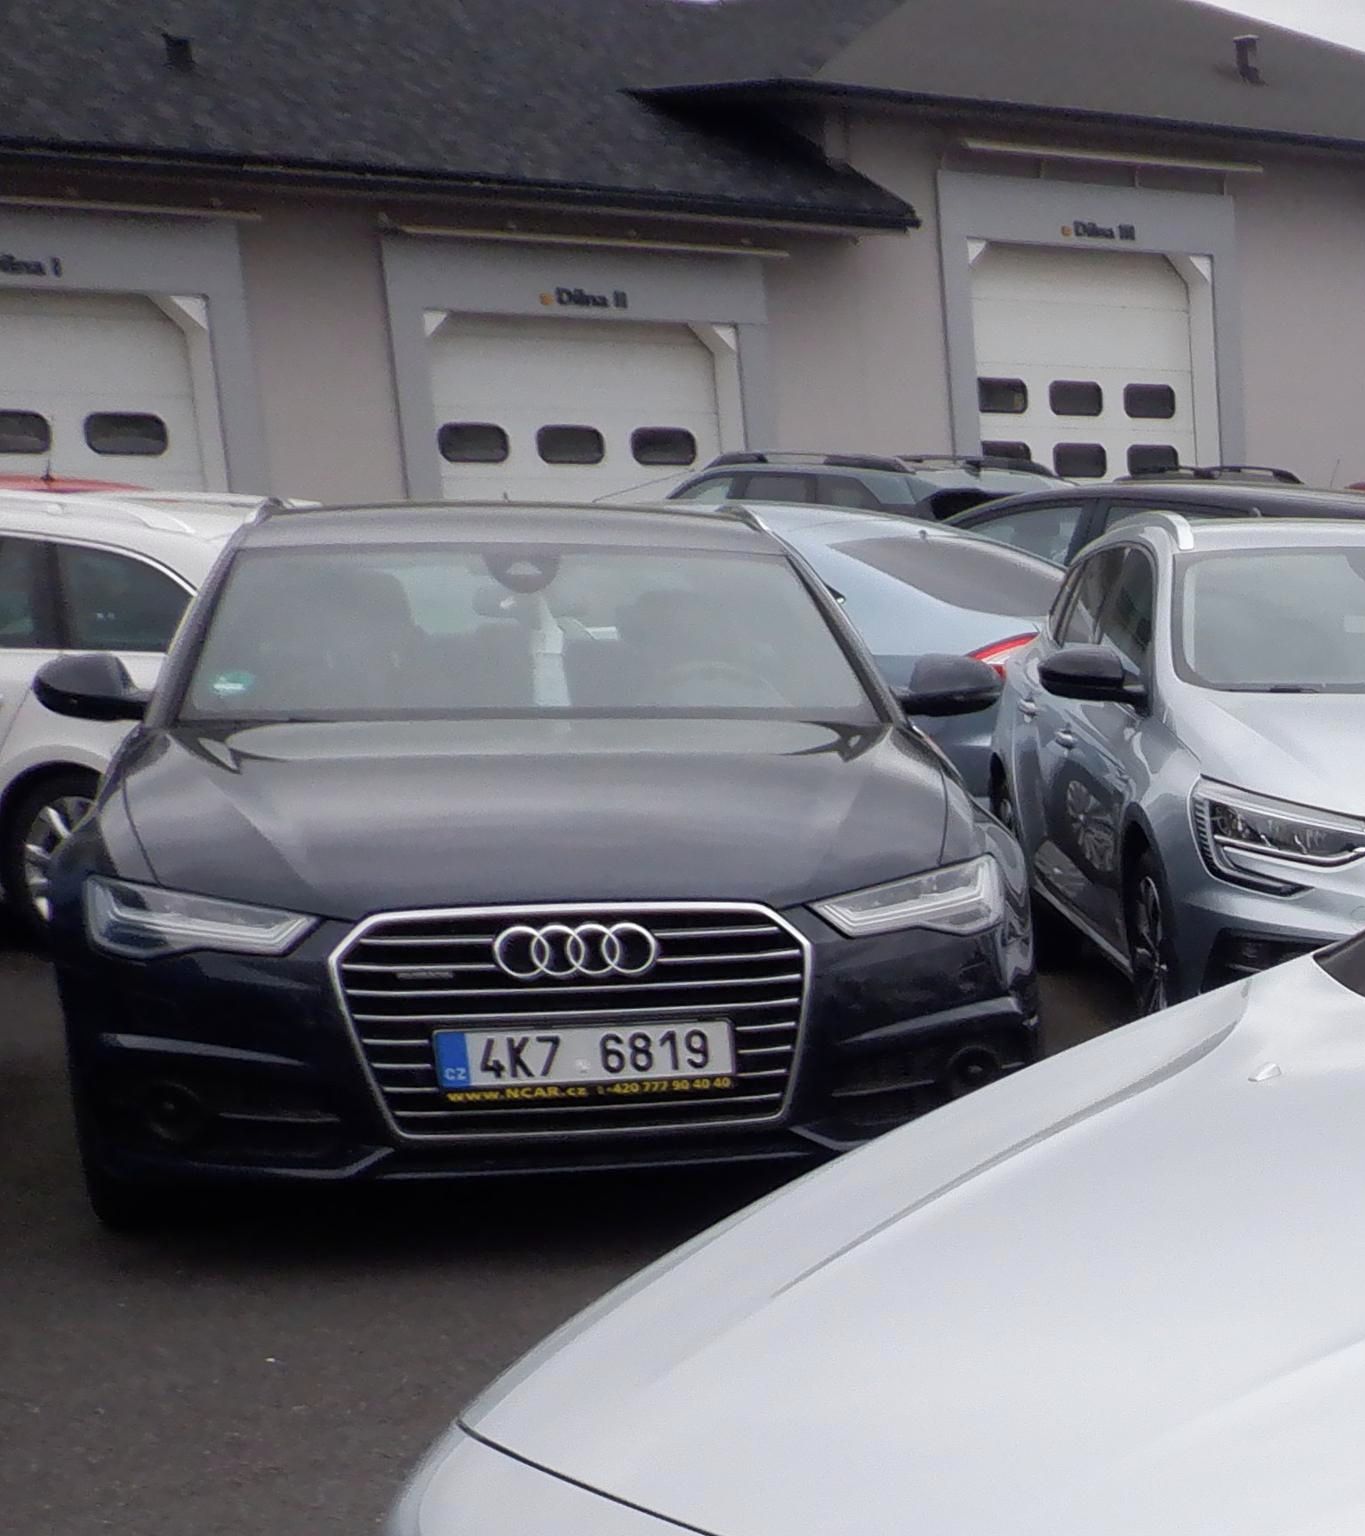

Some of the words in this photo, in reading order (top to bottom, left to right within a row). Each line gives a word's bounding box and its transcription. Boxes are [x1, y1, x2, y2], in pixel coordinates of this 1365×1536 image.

[480, 1035, 560, 1078] 4K7
[599, 1028, 709, 1074] 6819
[444, 1067, 467, 1081] CZ
[643, 1081, 668, 1093] 777
[672, 1078, 690, 1091] 90
[693, 1077, 711, 1089] 40
[713, 1076, 732, 1088] 40
